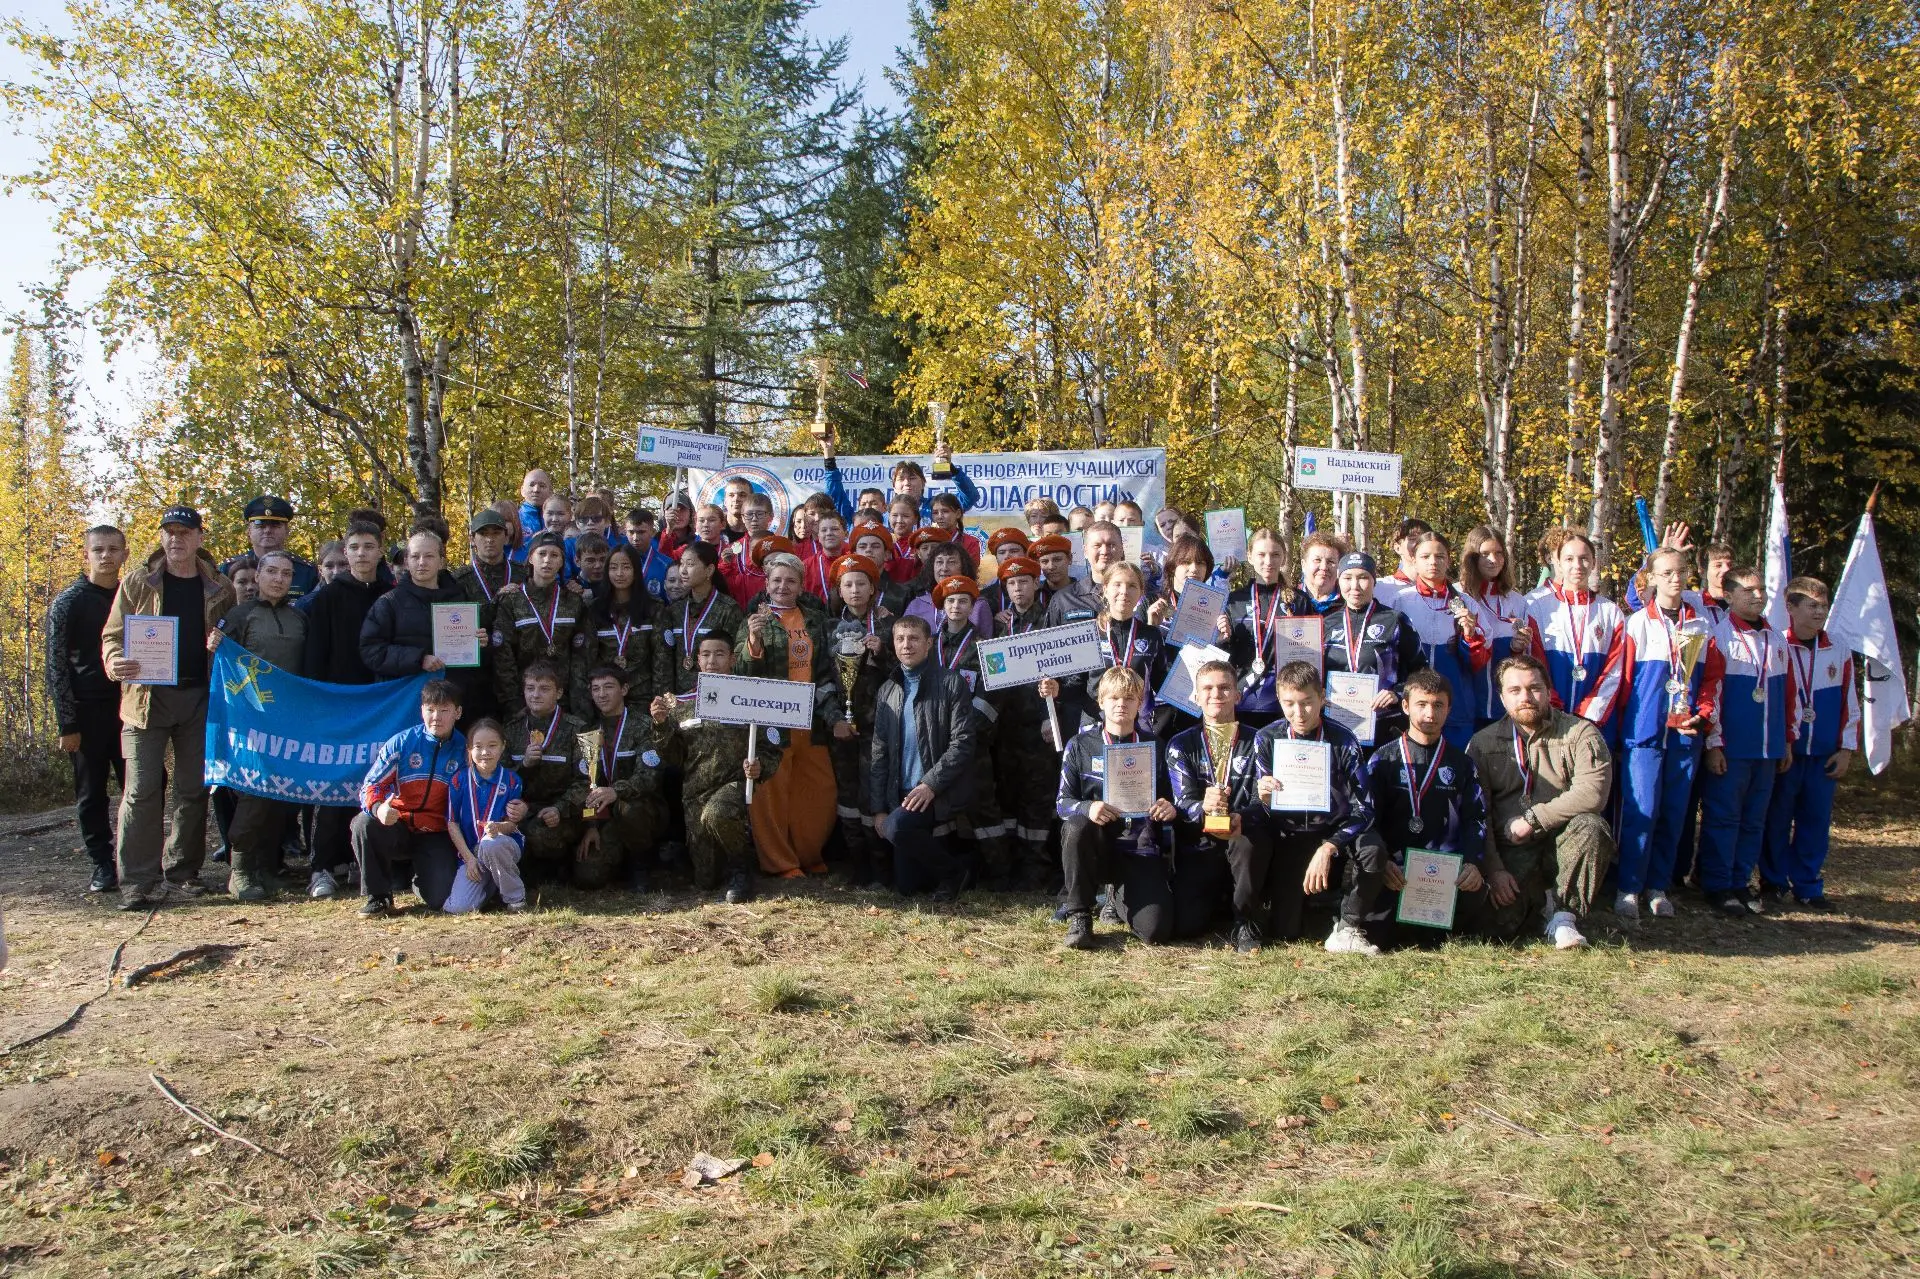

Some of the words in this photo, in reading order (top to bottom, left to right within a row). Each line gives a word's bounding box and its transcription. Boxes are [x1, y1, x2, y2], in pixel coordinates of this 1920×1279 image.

[659, 435, 724, 452] Шурышкарский
[677, 450, 702, 461] район
[1327, 456, 1391, 471] Надымский
[793, 464, 885, 483] ОКРЖНОЙ
[1066, 459, 1157, 478] УЧАЩИХСЯ
[1342, 472, 1375, 485] район
[1008, 629, 1095, 659] Приуральский
[1036, 653, 1073, 672] район
[730, 694, 801, 714] Салехард
